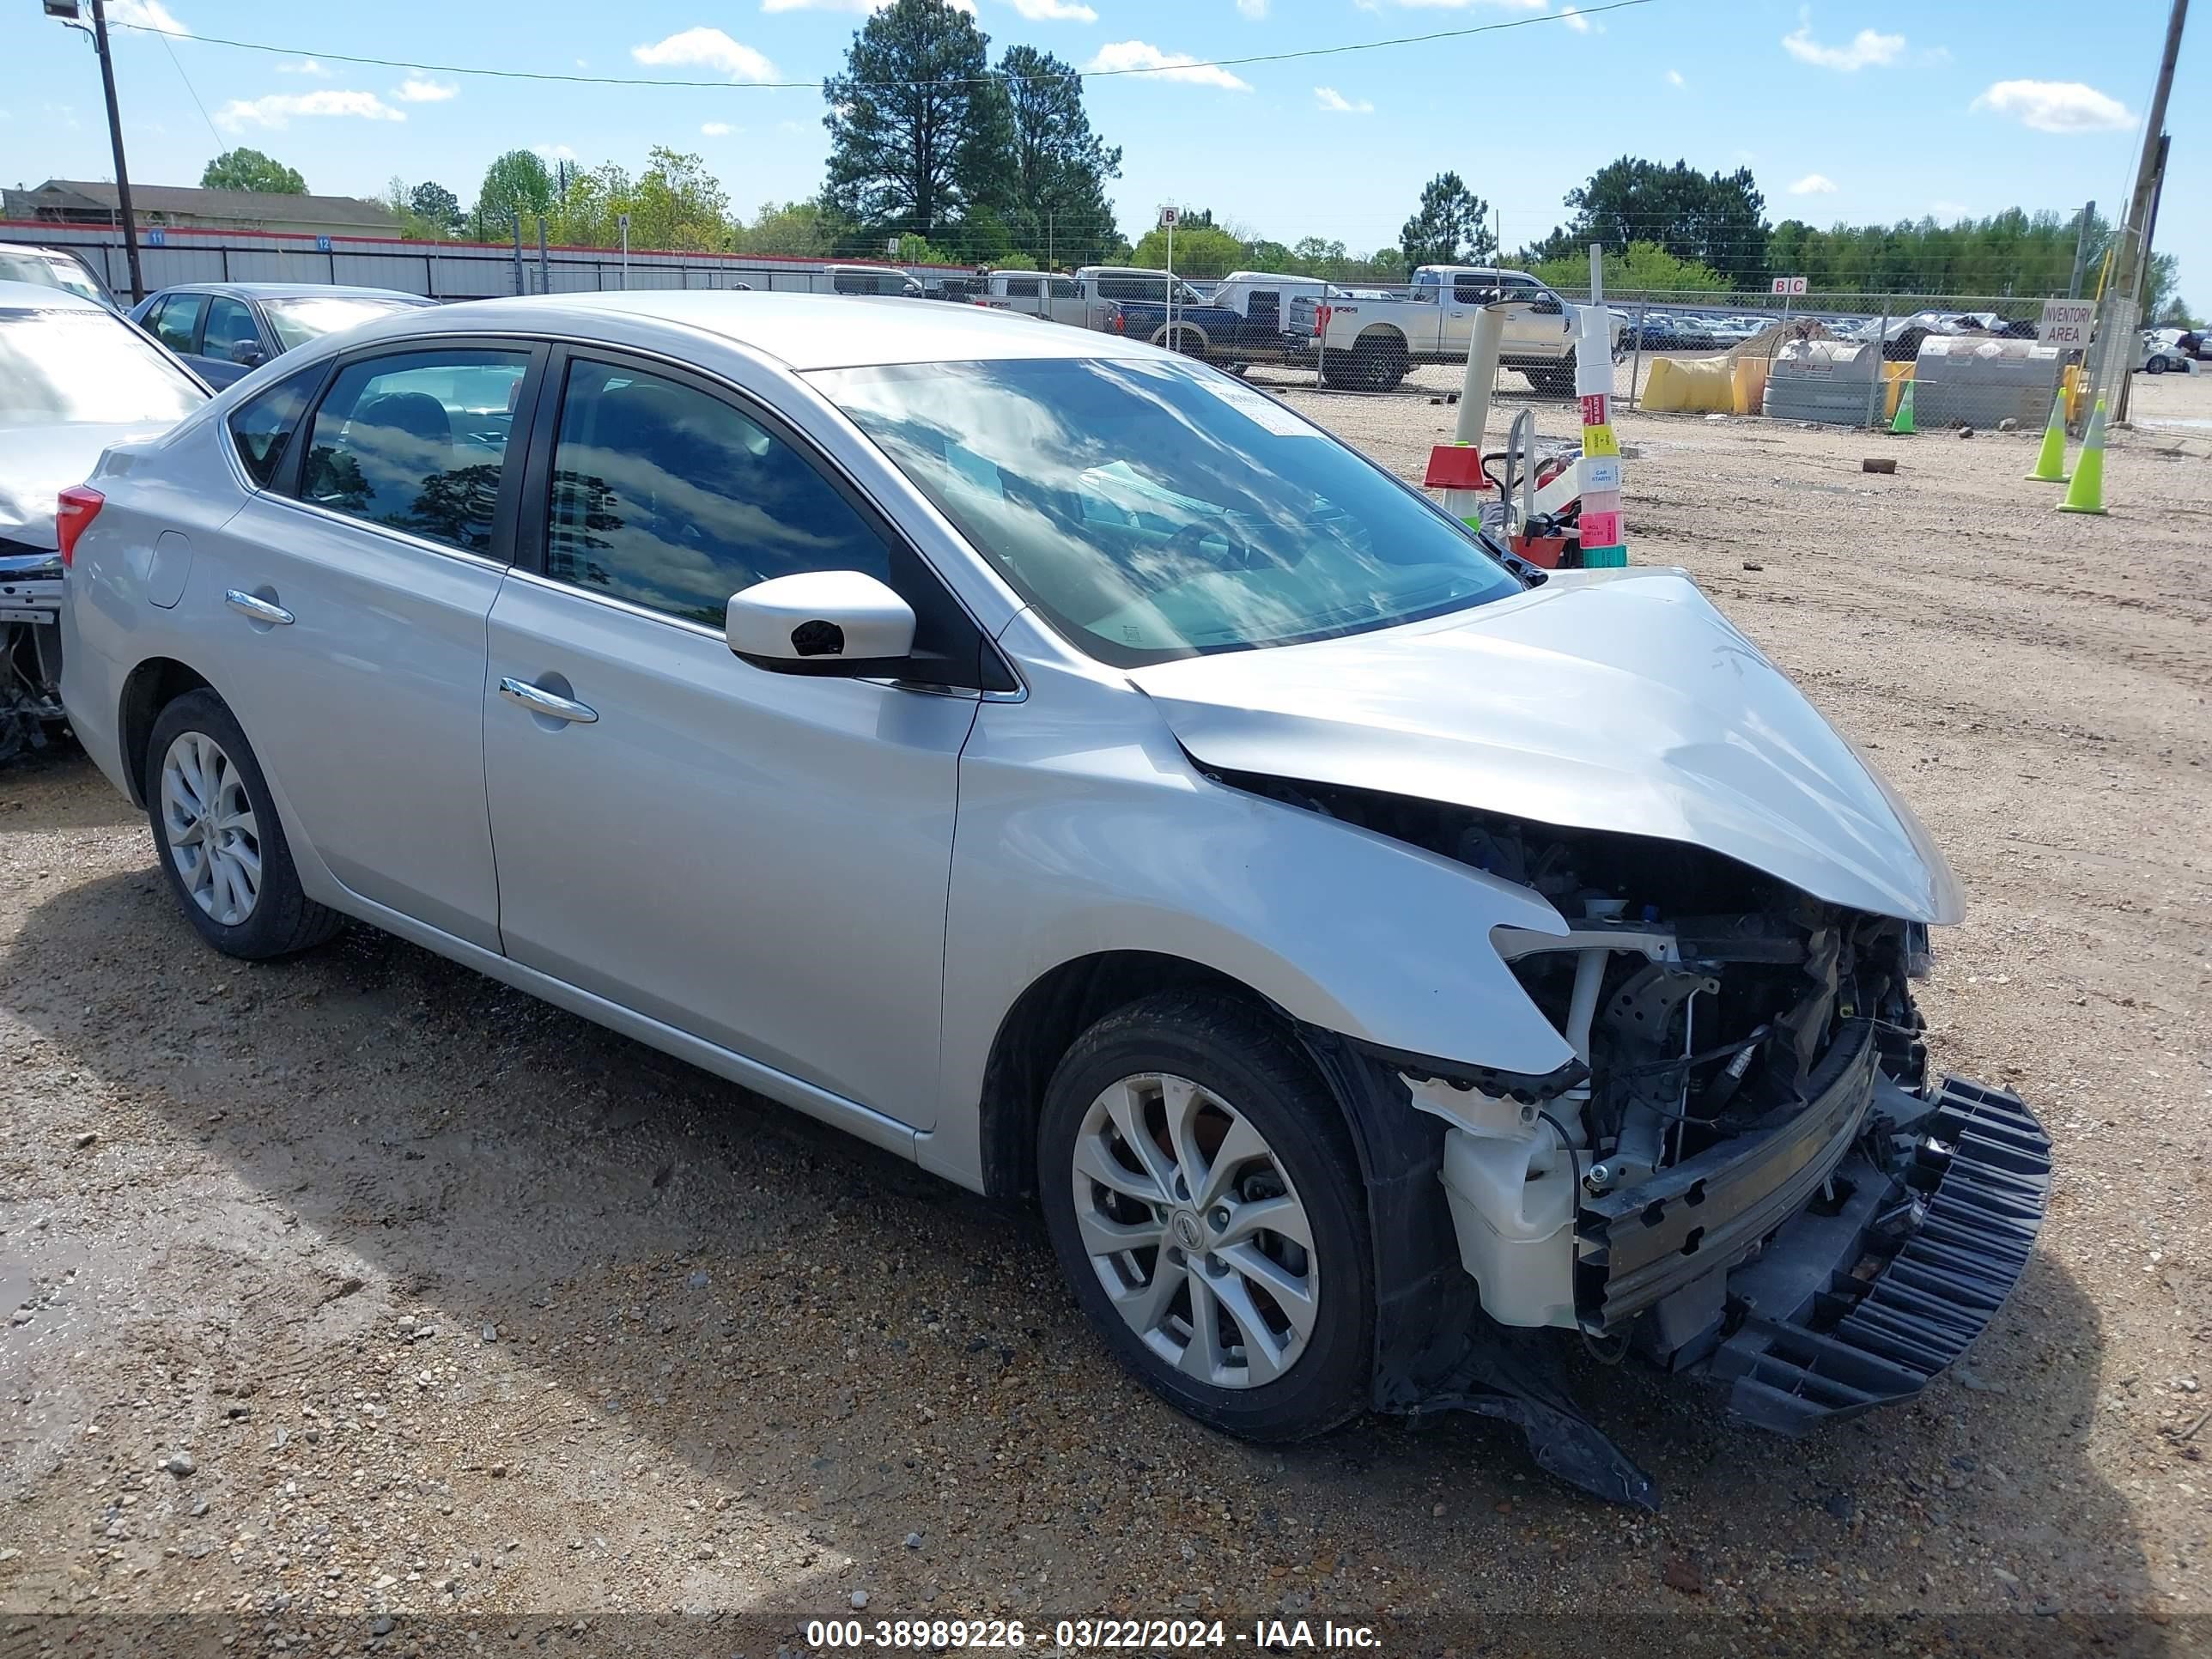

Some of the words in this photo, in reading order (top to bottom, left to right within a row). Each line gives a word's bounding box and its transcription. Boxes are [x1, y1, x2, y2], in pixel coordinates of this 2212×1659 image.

[621, 216, 628, 227] A
[1165, 210, 1175, 222] B
[152, 233, 162, 244] 11
[319, 238, 330, 249] 12
[889, 240, 897, 253] A
[1776, 280, 1784, 293] B
[1793, 280, 1803, 292] C
[2045, 306, 2094, 324] INVENTORY
[2047, 326, 2080, 342] AREA
